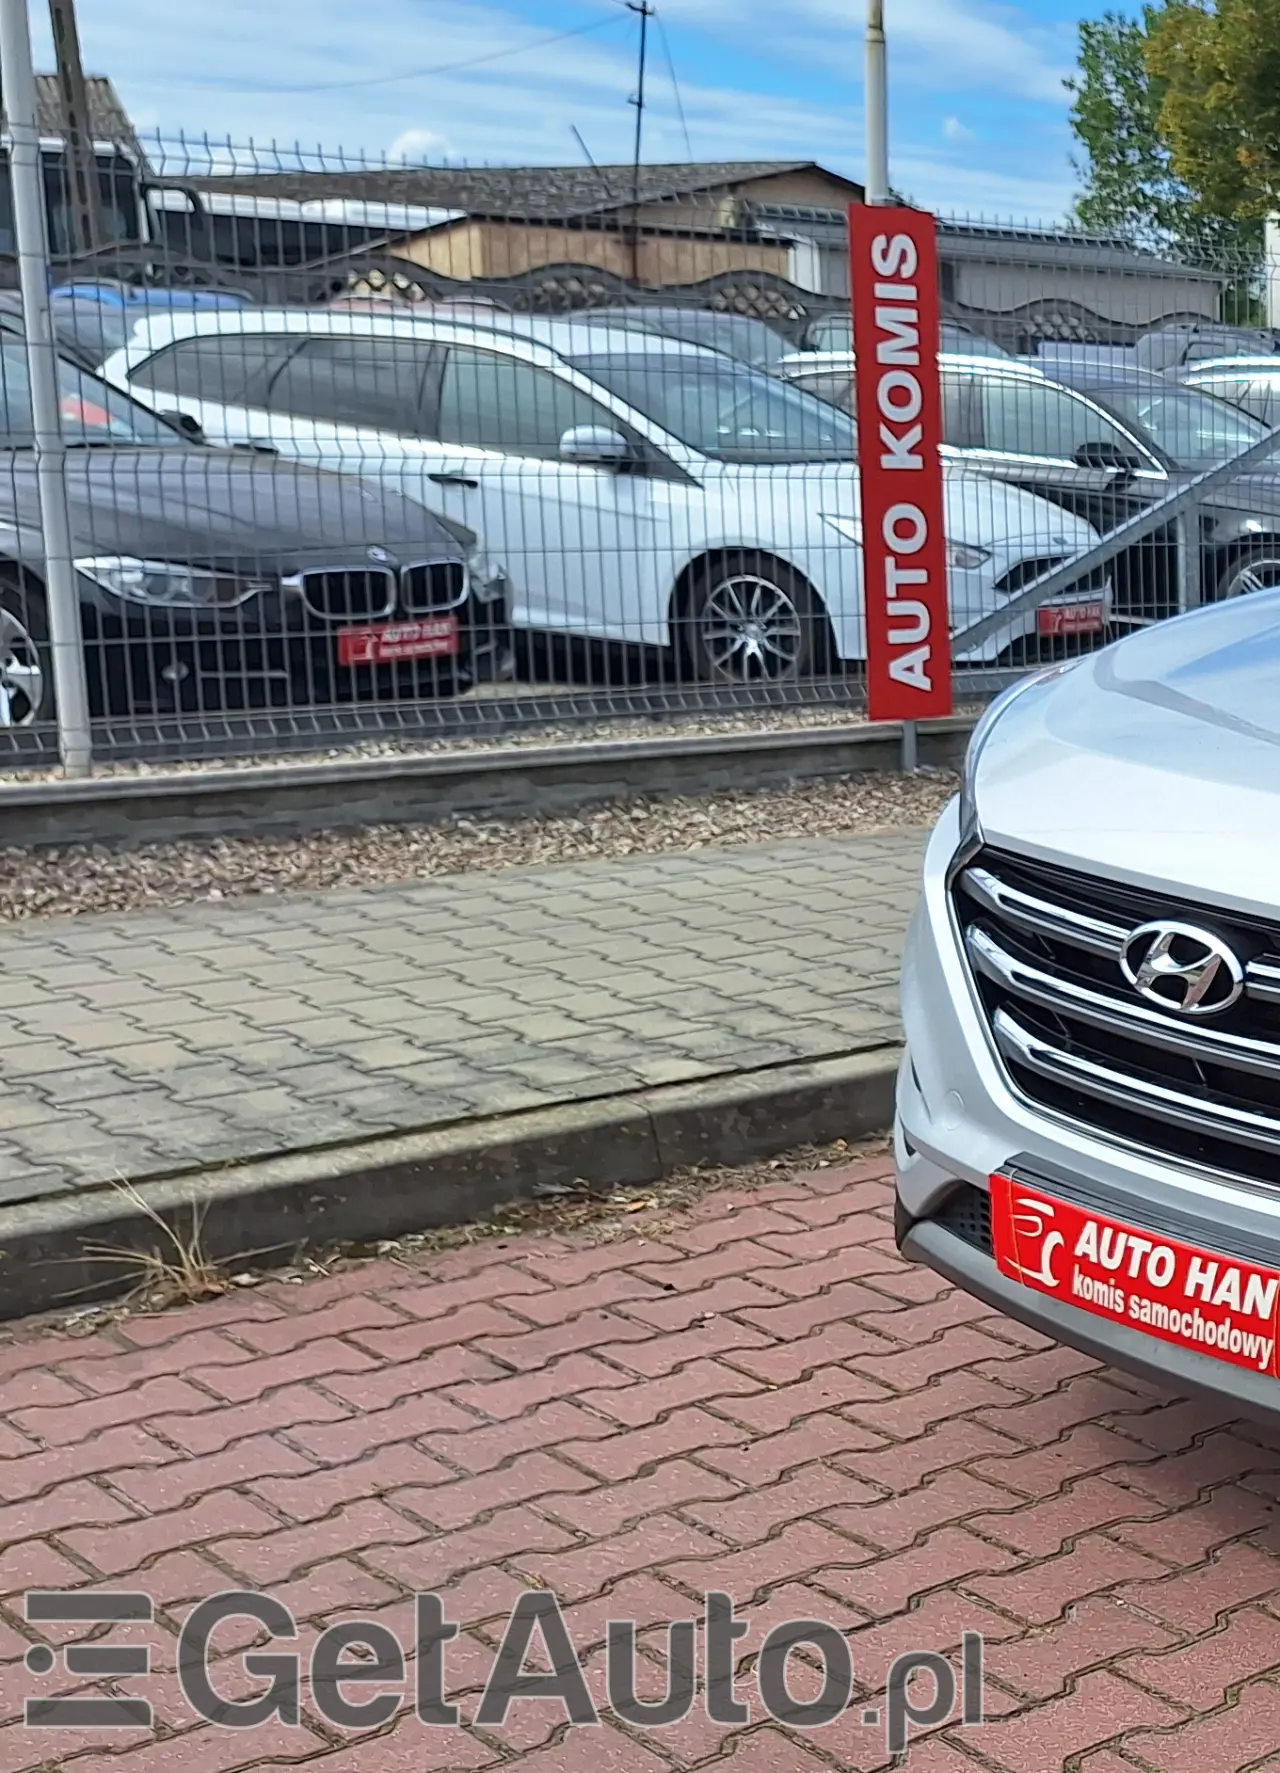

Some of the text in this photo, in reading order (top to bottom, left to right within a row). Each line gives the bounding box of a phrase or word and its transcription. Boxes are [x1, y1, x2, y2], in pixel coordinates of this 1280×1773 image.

[871, 232, 932, 692] AUTO KOMIS
[1071, 1264, 1274, 1370] komis samochodowy
[1073, 1220, 1279, 1320] AUTO HAN
